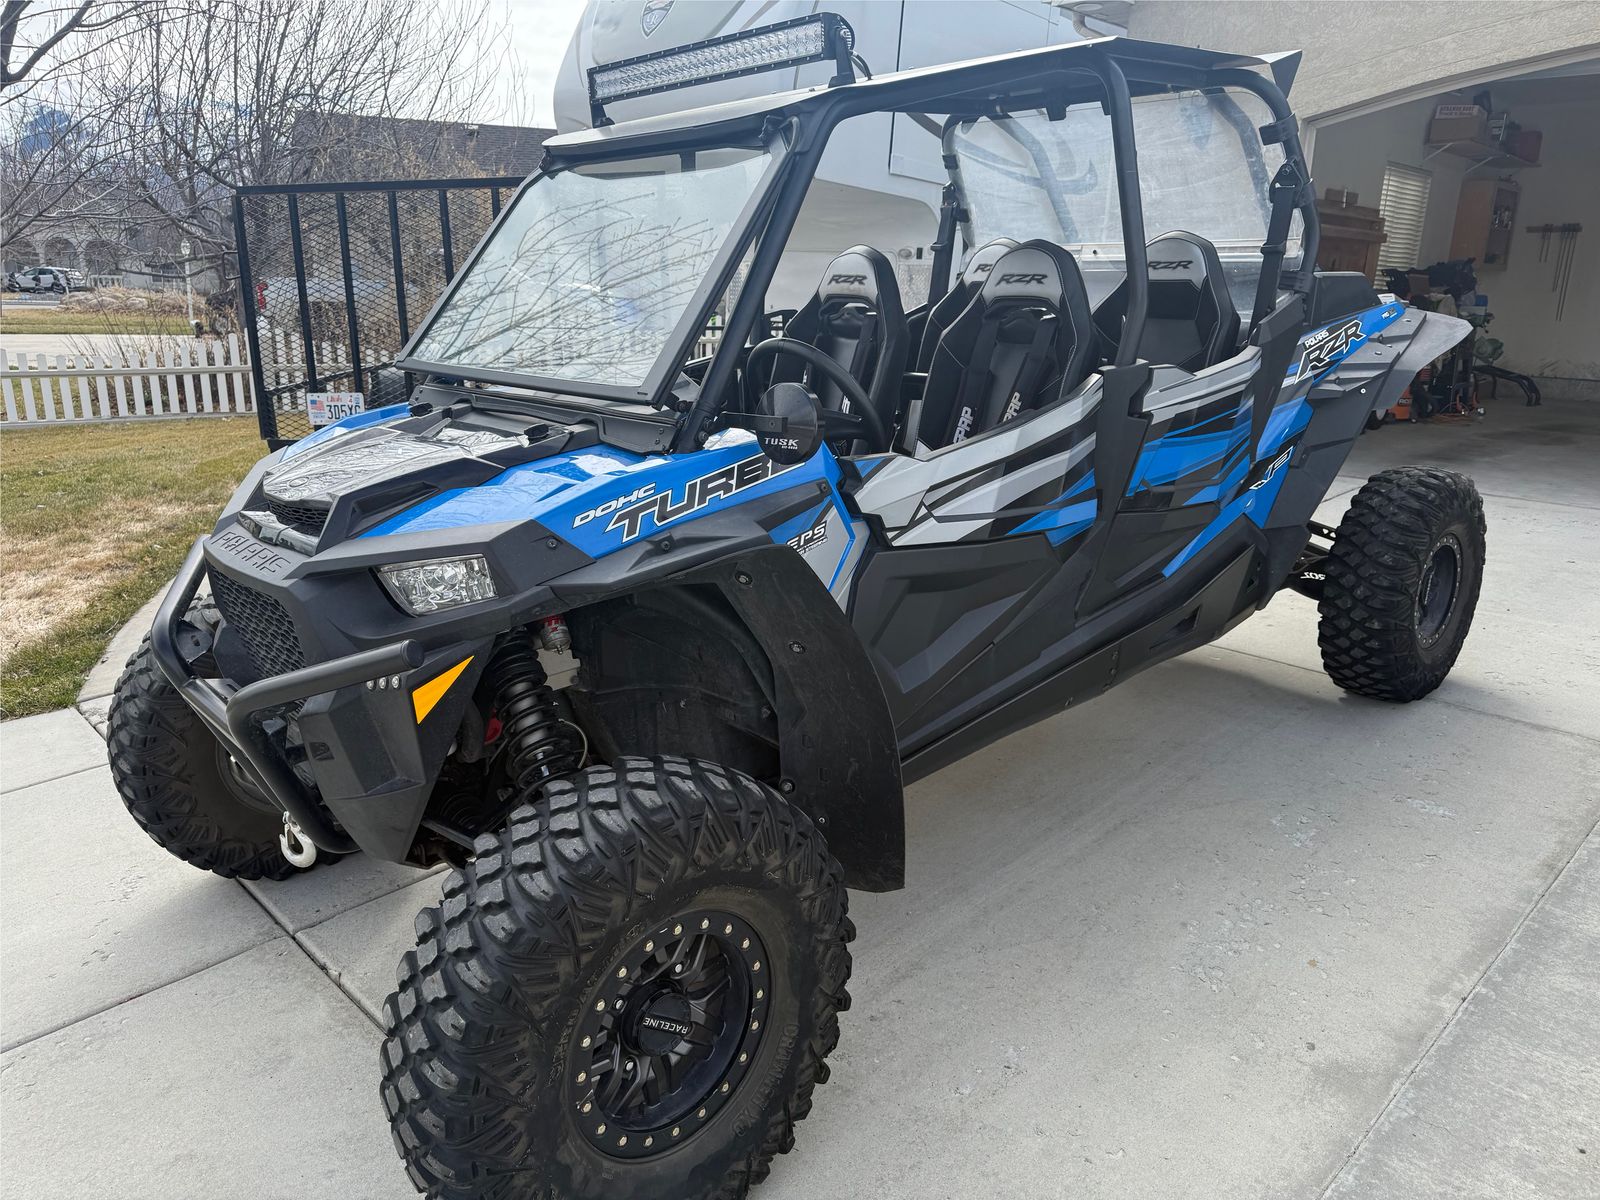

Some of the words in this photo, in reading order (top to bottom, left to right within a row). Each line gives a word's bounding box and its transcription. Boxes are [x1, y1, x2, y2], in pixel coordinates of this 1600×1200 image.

[827, 274, 868, 286] RZR
[995, 273, 1048, 287] RZR
[1304, 329, 1330, 348] POLARIS
[1294, 319, 1367, 384] RZR
[764, 437, 799, 447] TUSK
[572, 482, 657, 529] DOHC
[604, 453, 806, 544] TURB
[786, 522, 827, 549] EPS
[210, 531, 292, 573] POLARIS
[643, 1017, 689, 1034] RACELINE
